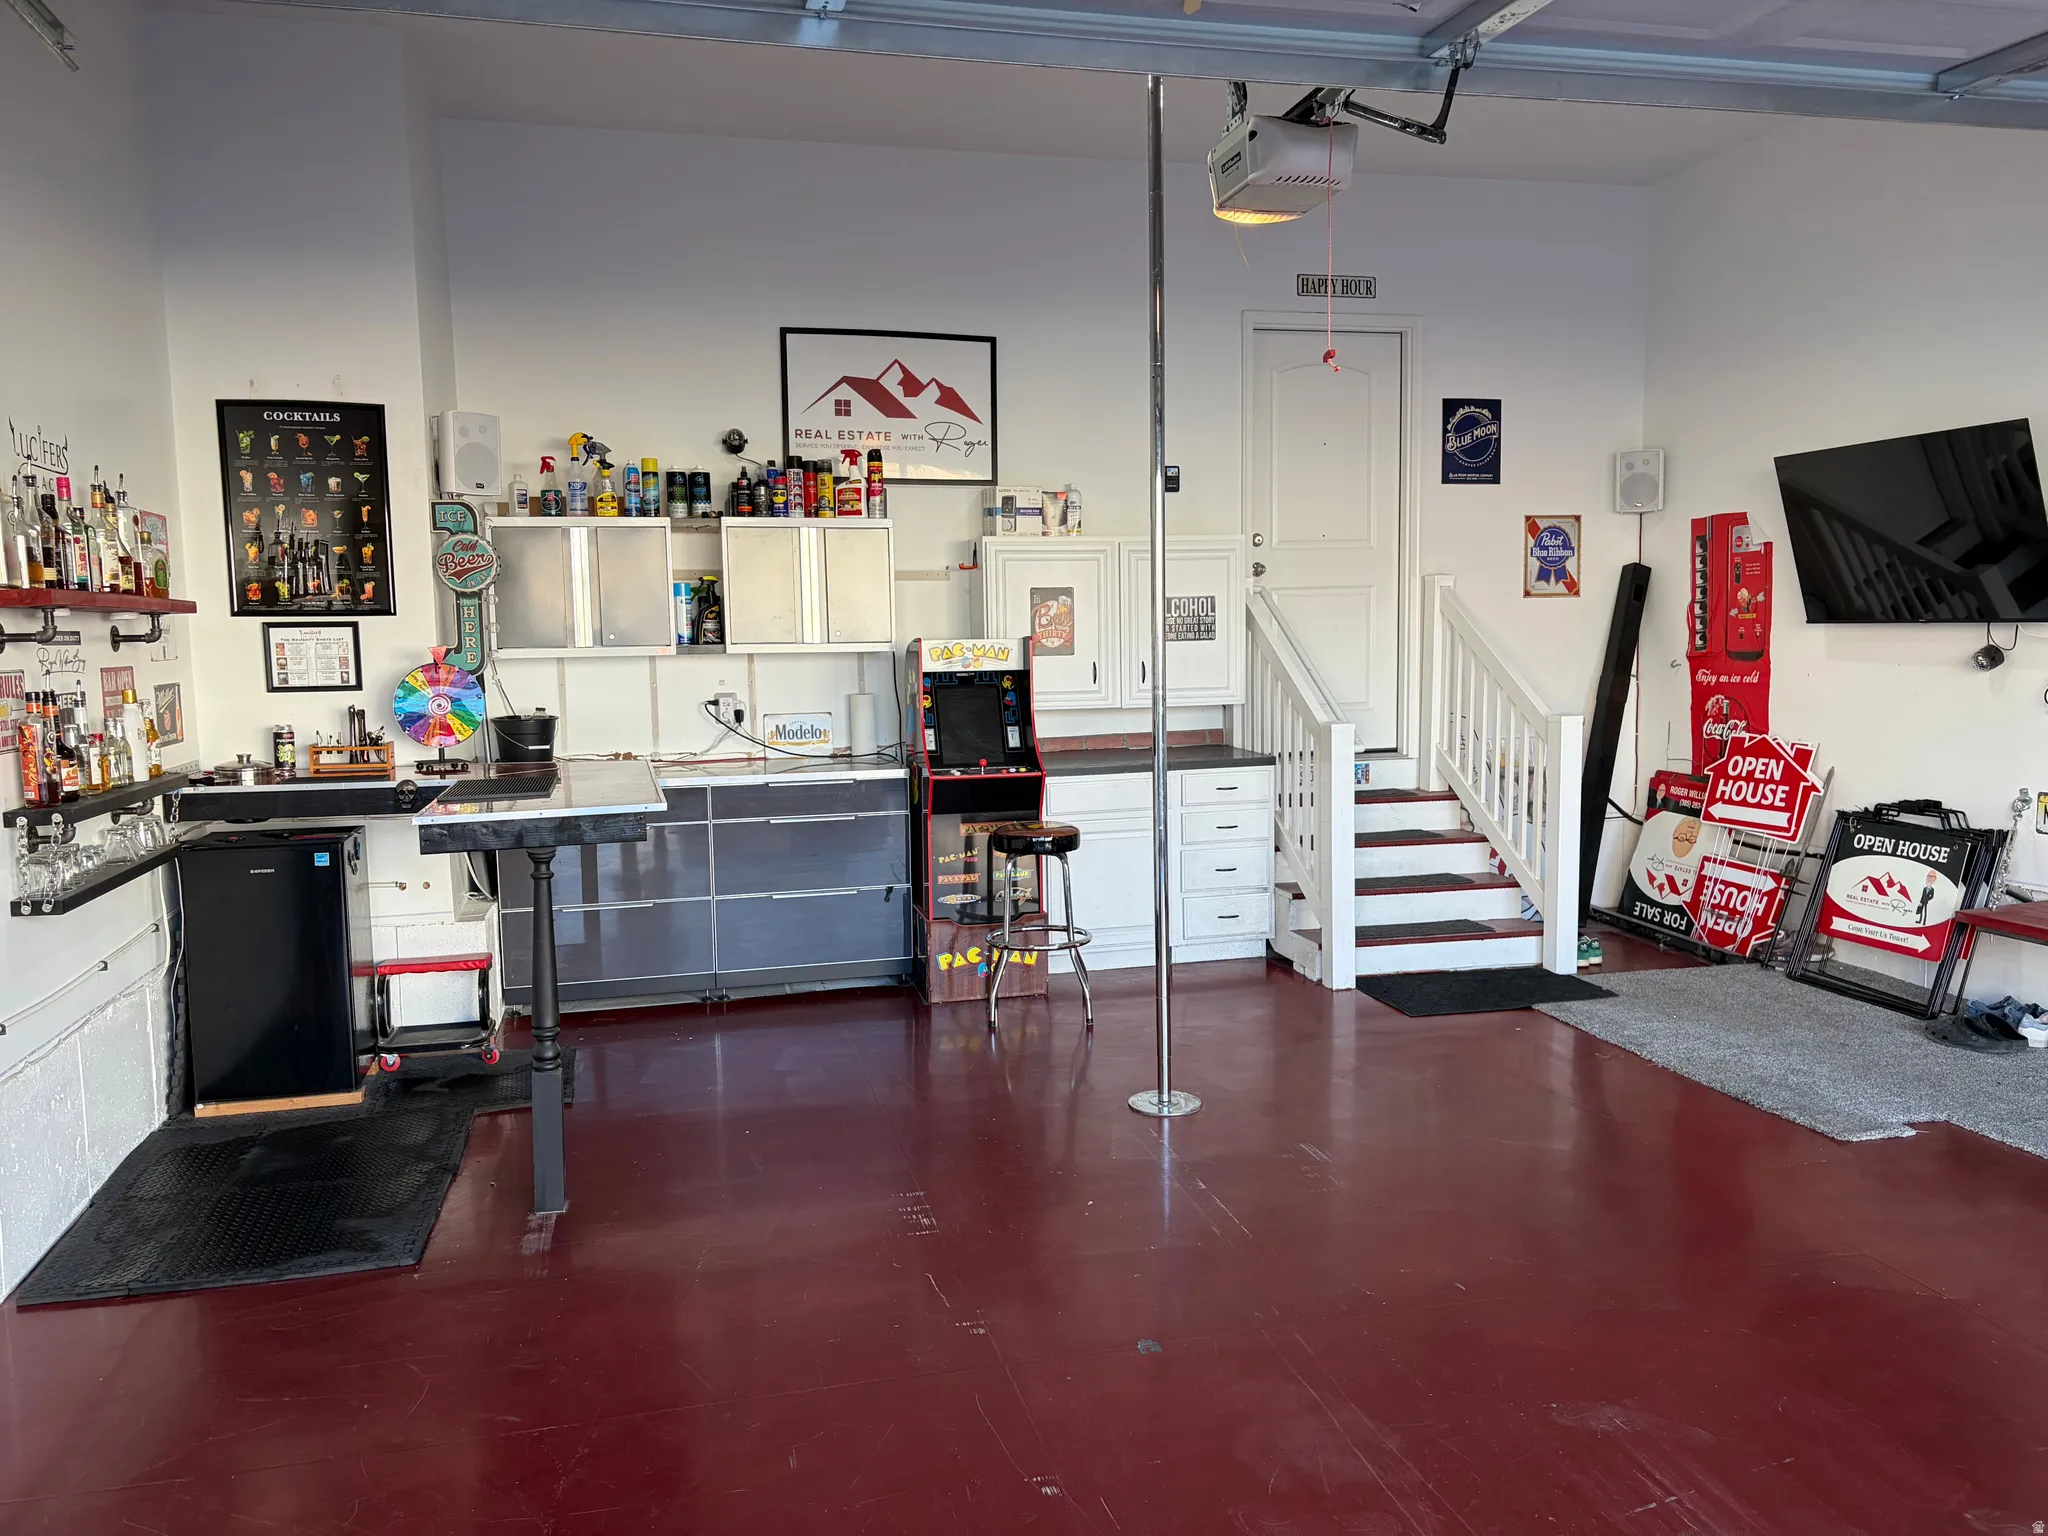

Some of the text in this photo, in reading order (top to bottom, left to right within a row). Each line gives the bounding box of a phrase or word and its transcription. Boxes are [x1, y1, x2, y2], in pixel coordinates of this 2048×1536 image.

[1301, 277, 1373, 296] HAPPY HOUR
[263, 411, 341, 422] COCKTAILS
[795, 428, 832, 440] REAL
[837, 430, 892, 442] ESTATE
[901, 433, 924, 441] WITH
[439, 510, 466, 522] ICE
[452, 539, 479, 553] Cold
[1540, 532, 1564, 546] Pabst
[1532, 546, 1573, 557] Blue Ribbon
[437, 552, 494, 574] Beer
[466, 570, 488, 588] ON TAP
[1165, 597, 1215, 617] LCOHOL
[1171, 624, 1199, 632] STARTED
[1200, 616, 1215, 624] STORY
[462, 605, 478, 664] HERE
[1038, 630, 1068, 639] THIRTY
[1178, 632, 1195, 640] EATING
[1195, 631, 1200, 639] A
[1200, 631, 1215, 639] SALAD
[928, 642, 1010, 662] PAC-MAN
[102, 671, 117, 691] BAR
[1695, 669, 1760, 686] Enjoy an ice cold
[775, 724, 822, 741] Modelo
[1727, 755, 1785, 781] OPEN
[1669, 785, 1689, 797] ROGER
[1715, 779, 1790, 807] HOUSE
[1853, 833, 1950, 864] OPEN HOUSE
[1700, 878, 1768, 917] HOUSE
[1846, 893, 1859, 901] REAL
[1860, 896, 1879, 905] ESTATE
[1633, 900, 1688, 931] FOR SALE
[1700, 908, 1752, 939] OPEN
